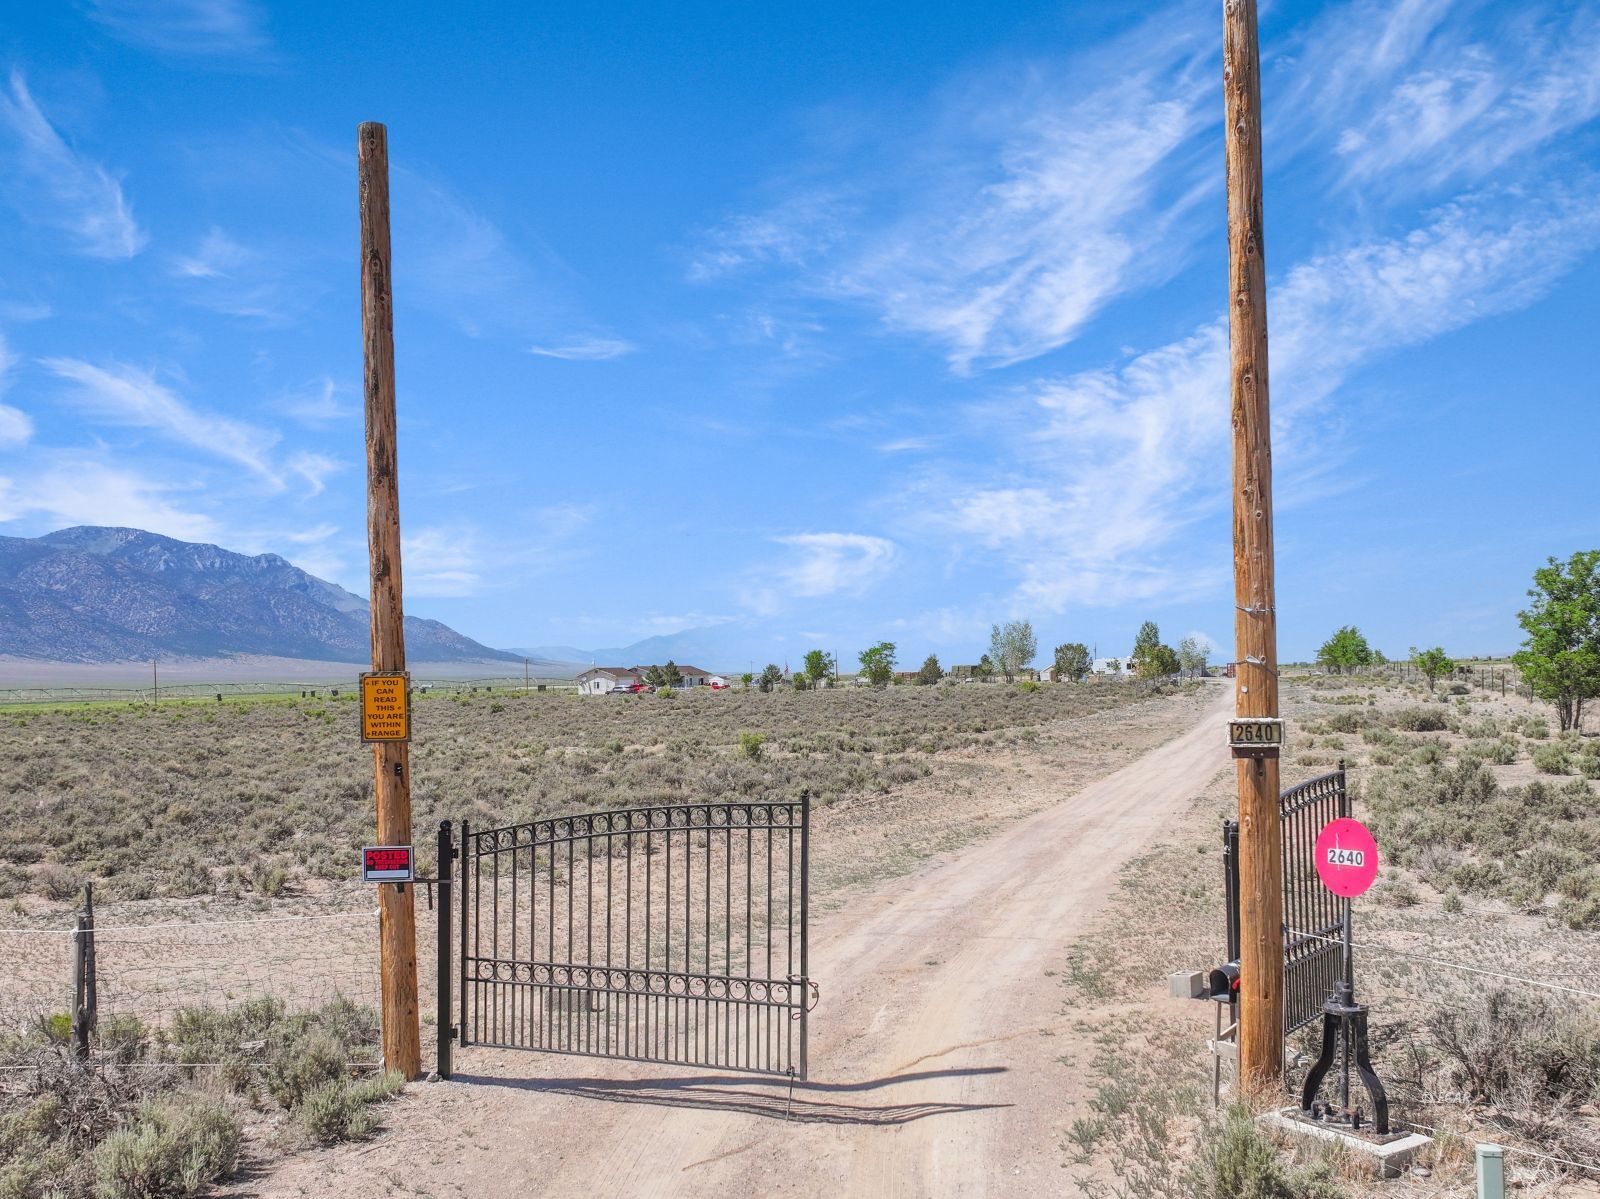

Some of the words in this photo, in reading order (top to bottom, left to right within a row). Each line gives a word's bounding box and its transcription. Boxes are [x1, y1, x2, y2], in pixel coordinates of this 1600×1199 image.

[1236, 725, 1273, 741] 2640
[366, 851, 409, 860] POSTED
[1328, 849, 1363, 866] 2640
